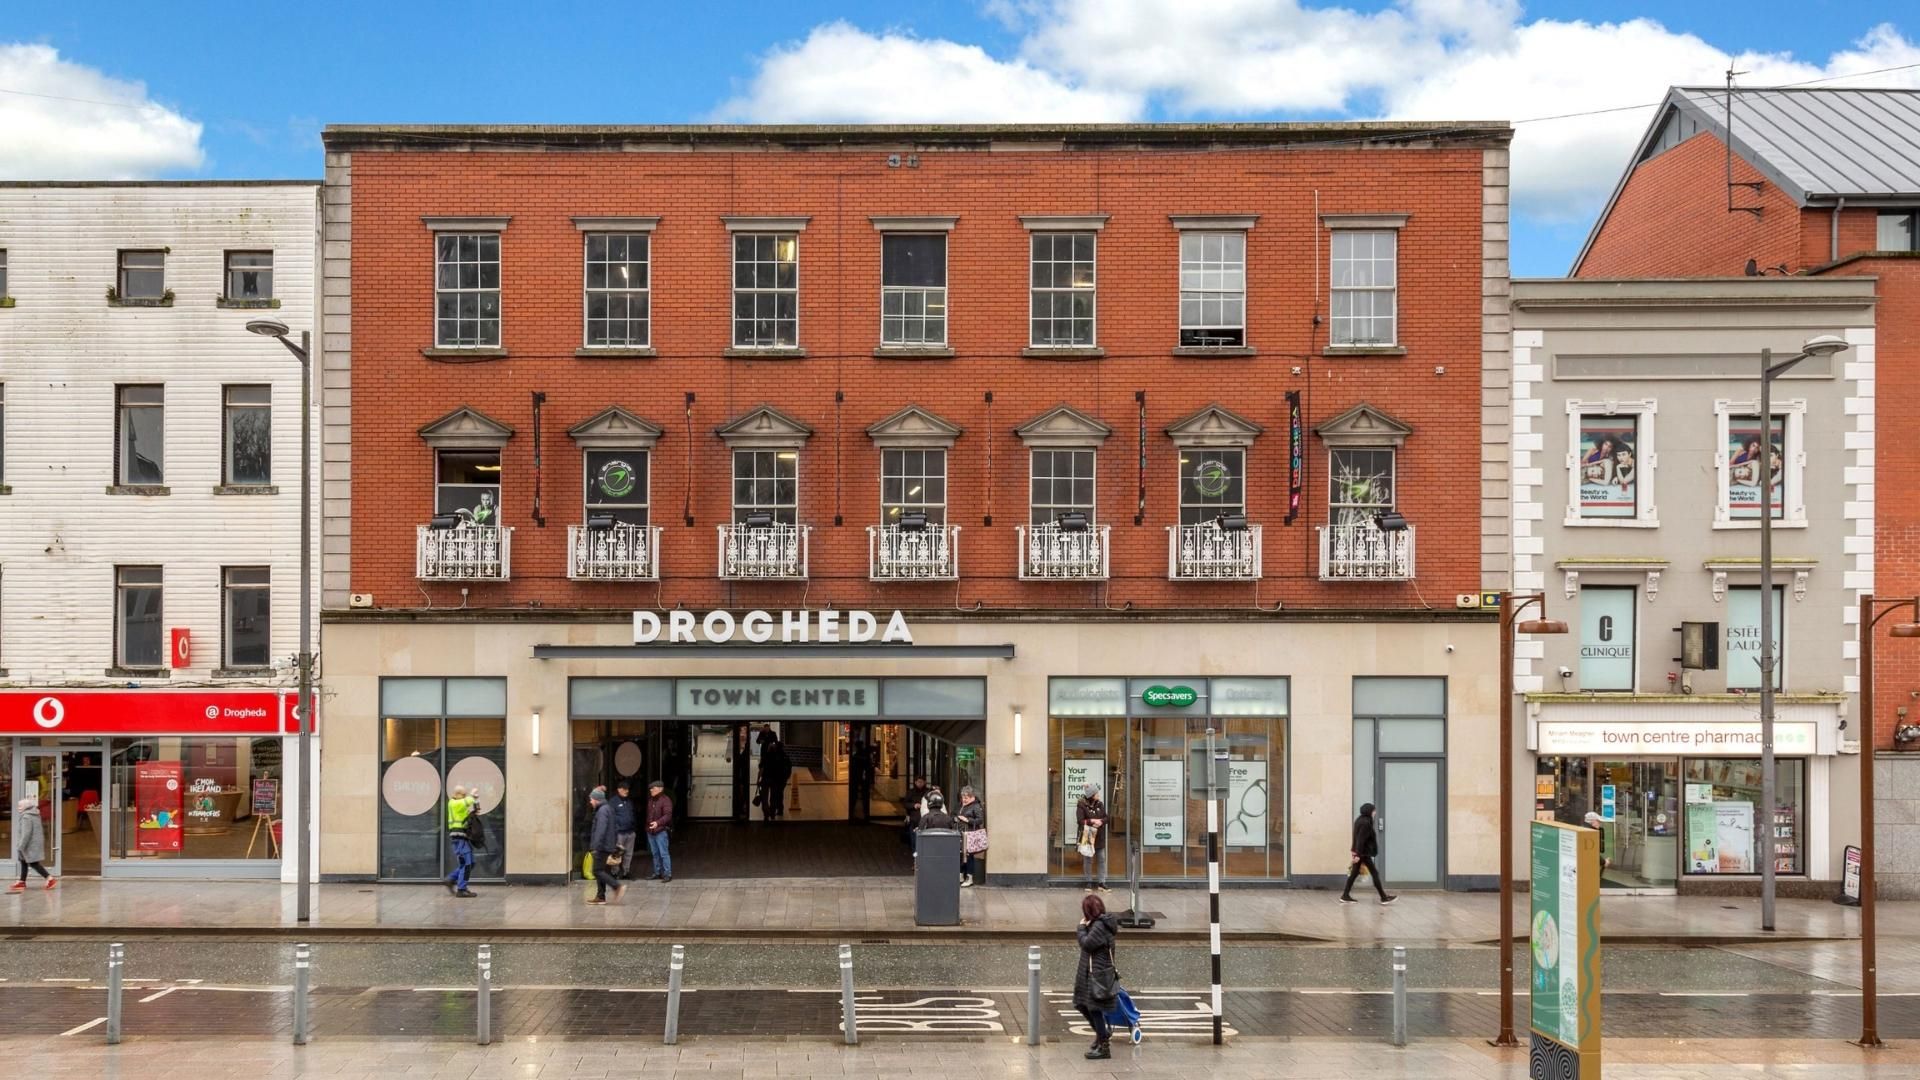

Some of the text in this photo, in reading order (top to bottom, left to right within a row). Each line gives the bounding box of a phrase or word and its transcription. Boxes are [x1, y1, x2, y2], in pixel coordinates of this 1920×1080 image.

[633, 610, 913, 643] DROGHEDA
[1727, 640, 1777, 650] LAUDR
[1580, 647, 1631, 657] CLINIQUE
[690, 688, 866, 706] TOWN CENTRE
[1148, 690, 1192, 702] Specsavers
[224, 707, 267, 719] Drogheda
[1603, 730, 1640, 744] town
[1643, 730, 1690, 744] centre
[1695, 730, 1765, 747] pharmac
[1068, 766, 1087, 774] Your
[1228, 767, 1248, 775] Free
[1068, 775, 1087, 783] first
[190, 785, 222, 793] IRELAND
[1068, 791, 1086, 799] free
[839, 997, 1004, 1031] BUS
